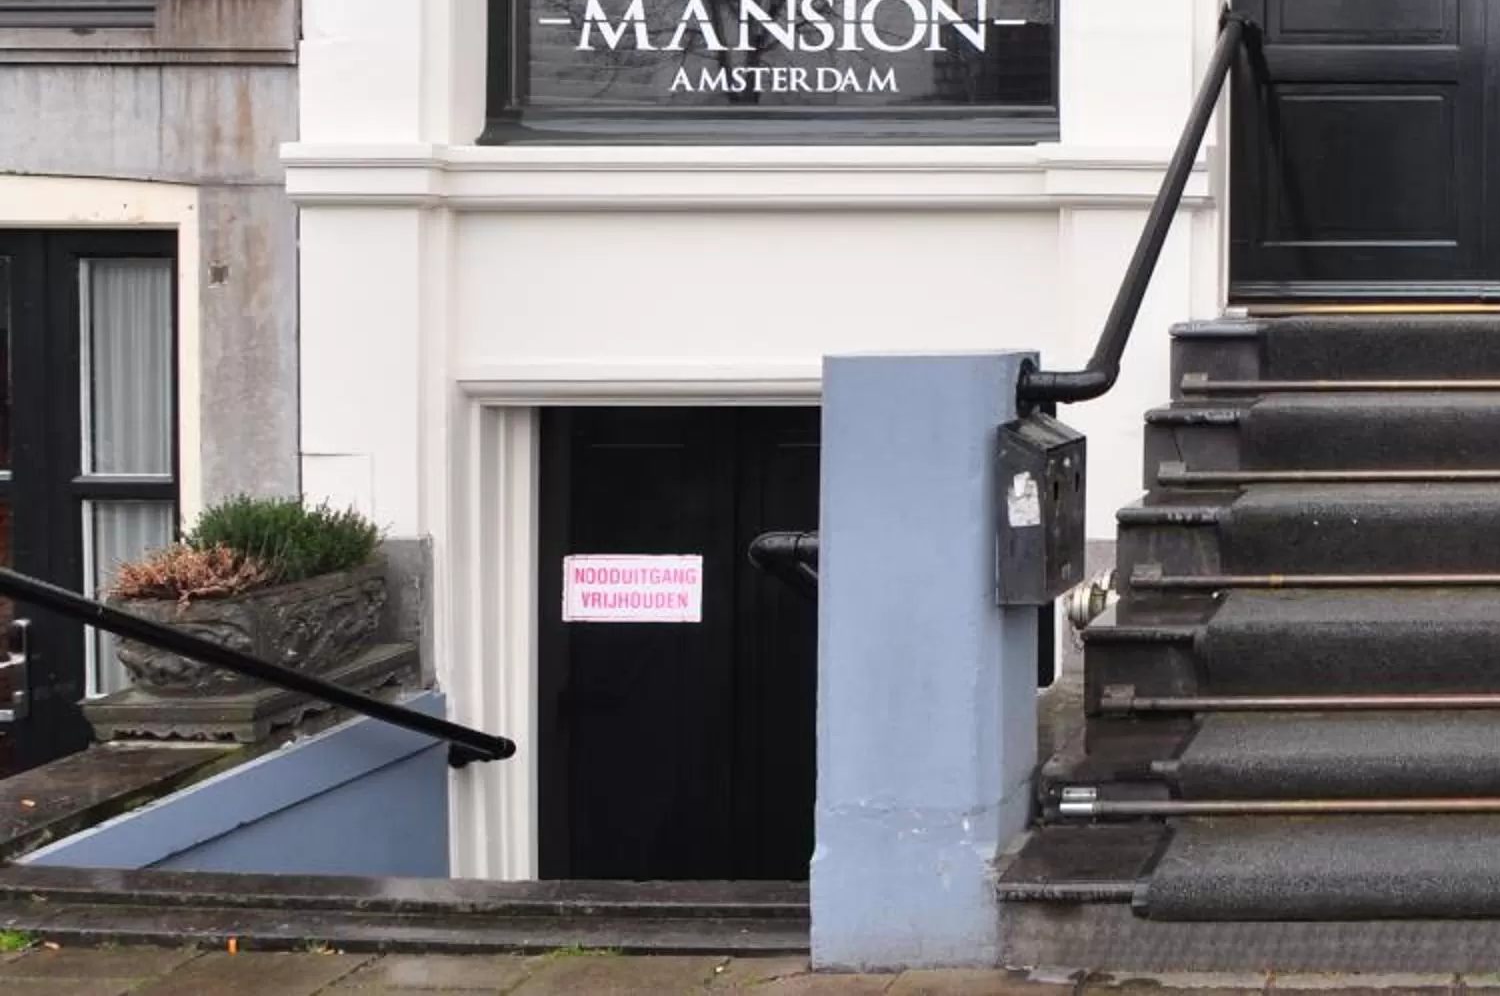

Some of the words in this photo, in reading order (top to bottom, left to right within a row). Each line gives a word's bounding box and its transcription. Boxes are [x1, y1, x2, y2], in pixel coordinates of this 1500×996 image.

[667, 67, 901, 94] AMSTERDAM
[574, 567, 698, 586] NOODUITGANG
[580, 590, 689, 610] VRIJHOUDEN
